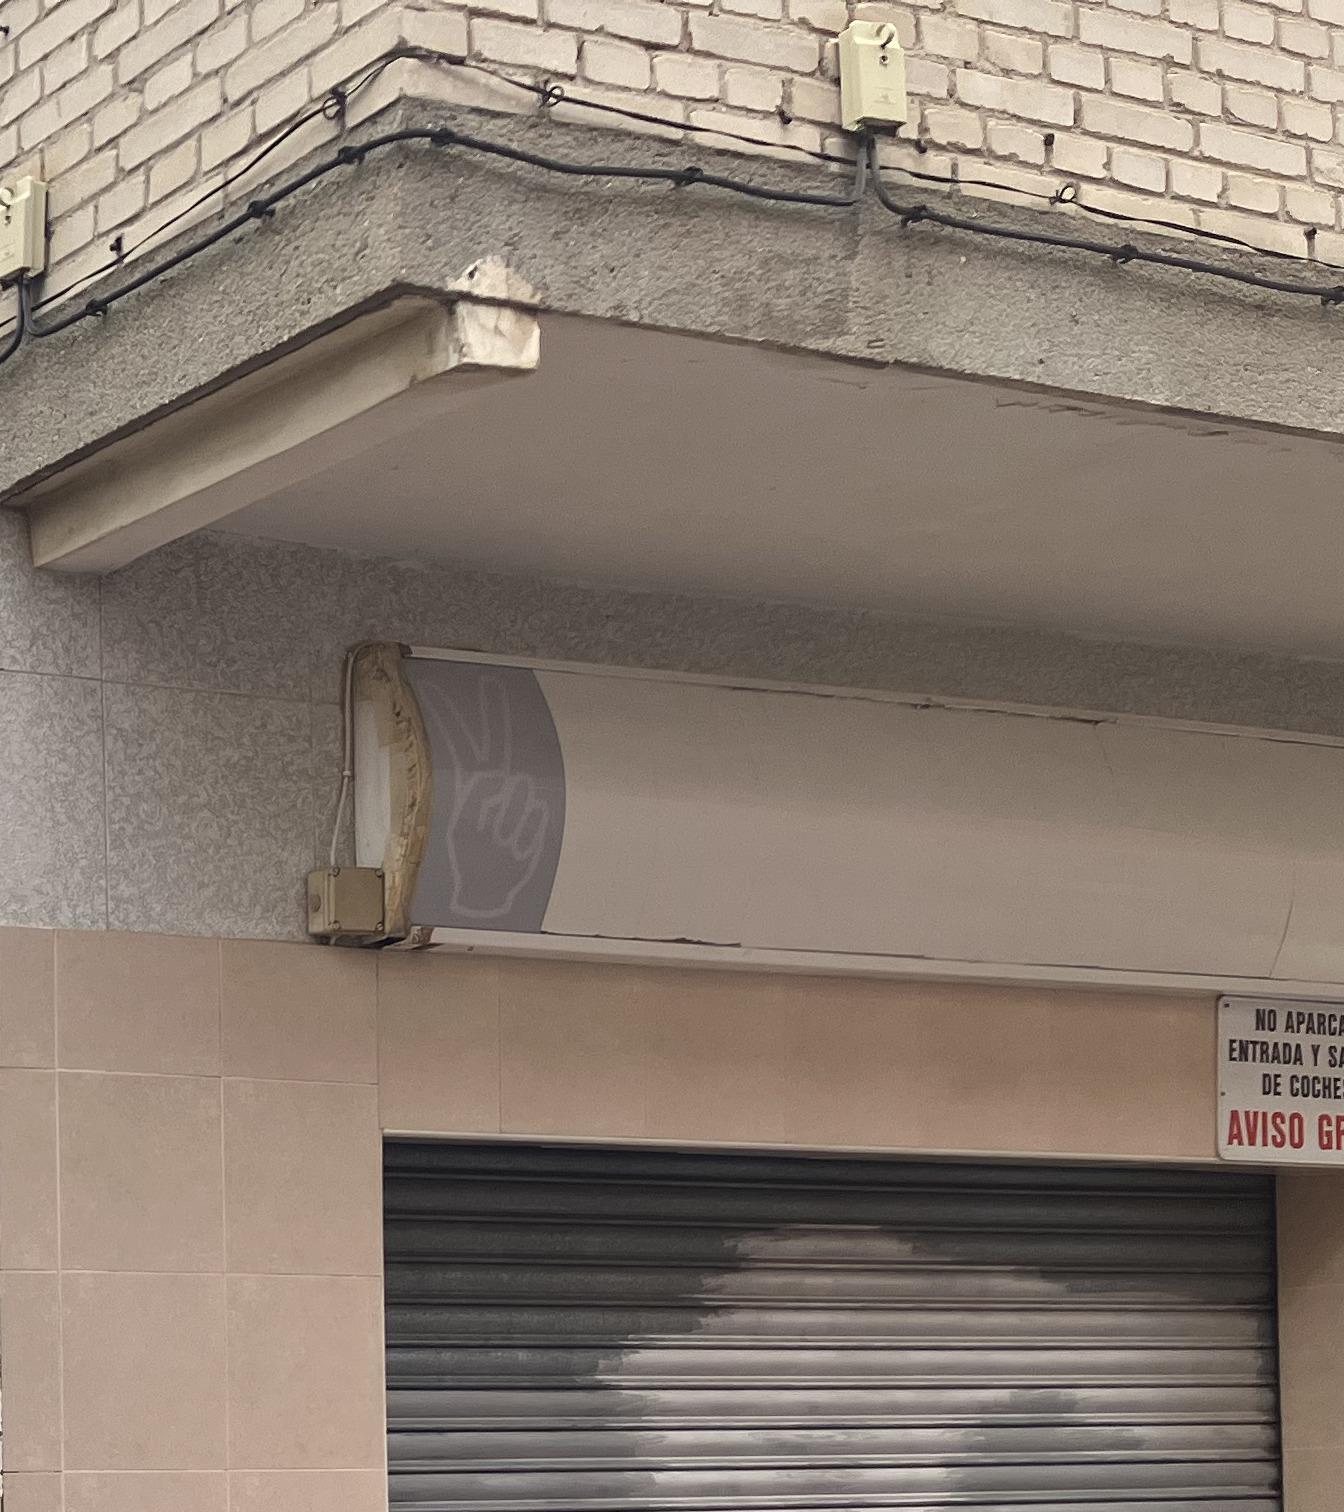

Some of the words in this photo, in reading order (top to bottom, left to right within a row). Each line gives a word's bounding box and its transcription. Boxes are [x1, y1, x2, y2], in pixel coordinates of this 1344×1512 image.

[1255, 1008, 1277, 1032] NO
[1228, 1038, 1304, 1066] ENTRADA
[1311, 1044, 1321, 1067] Y
[1262, 1073, 1282, 1096] DE
[1289, 1074, 1344, 1100] COCHE
[1227, 1109, 1305, 1149] AVISO
